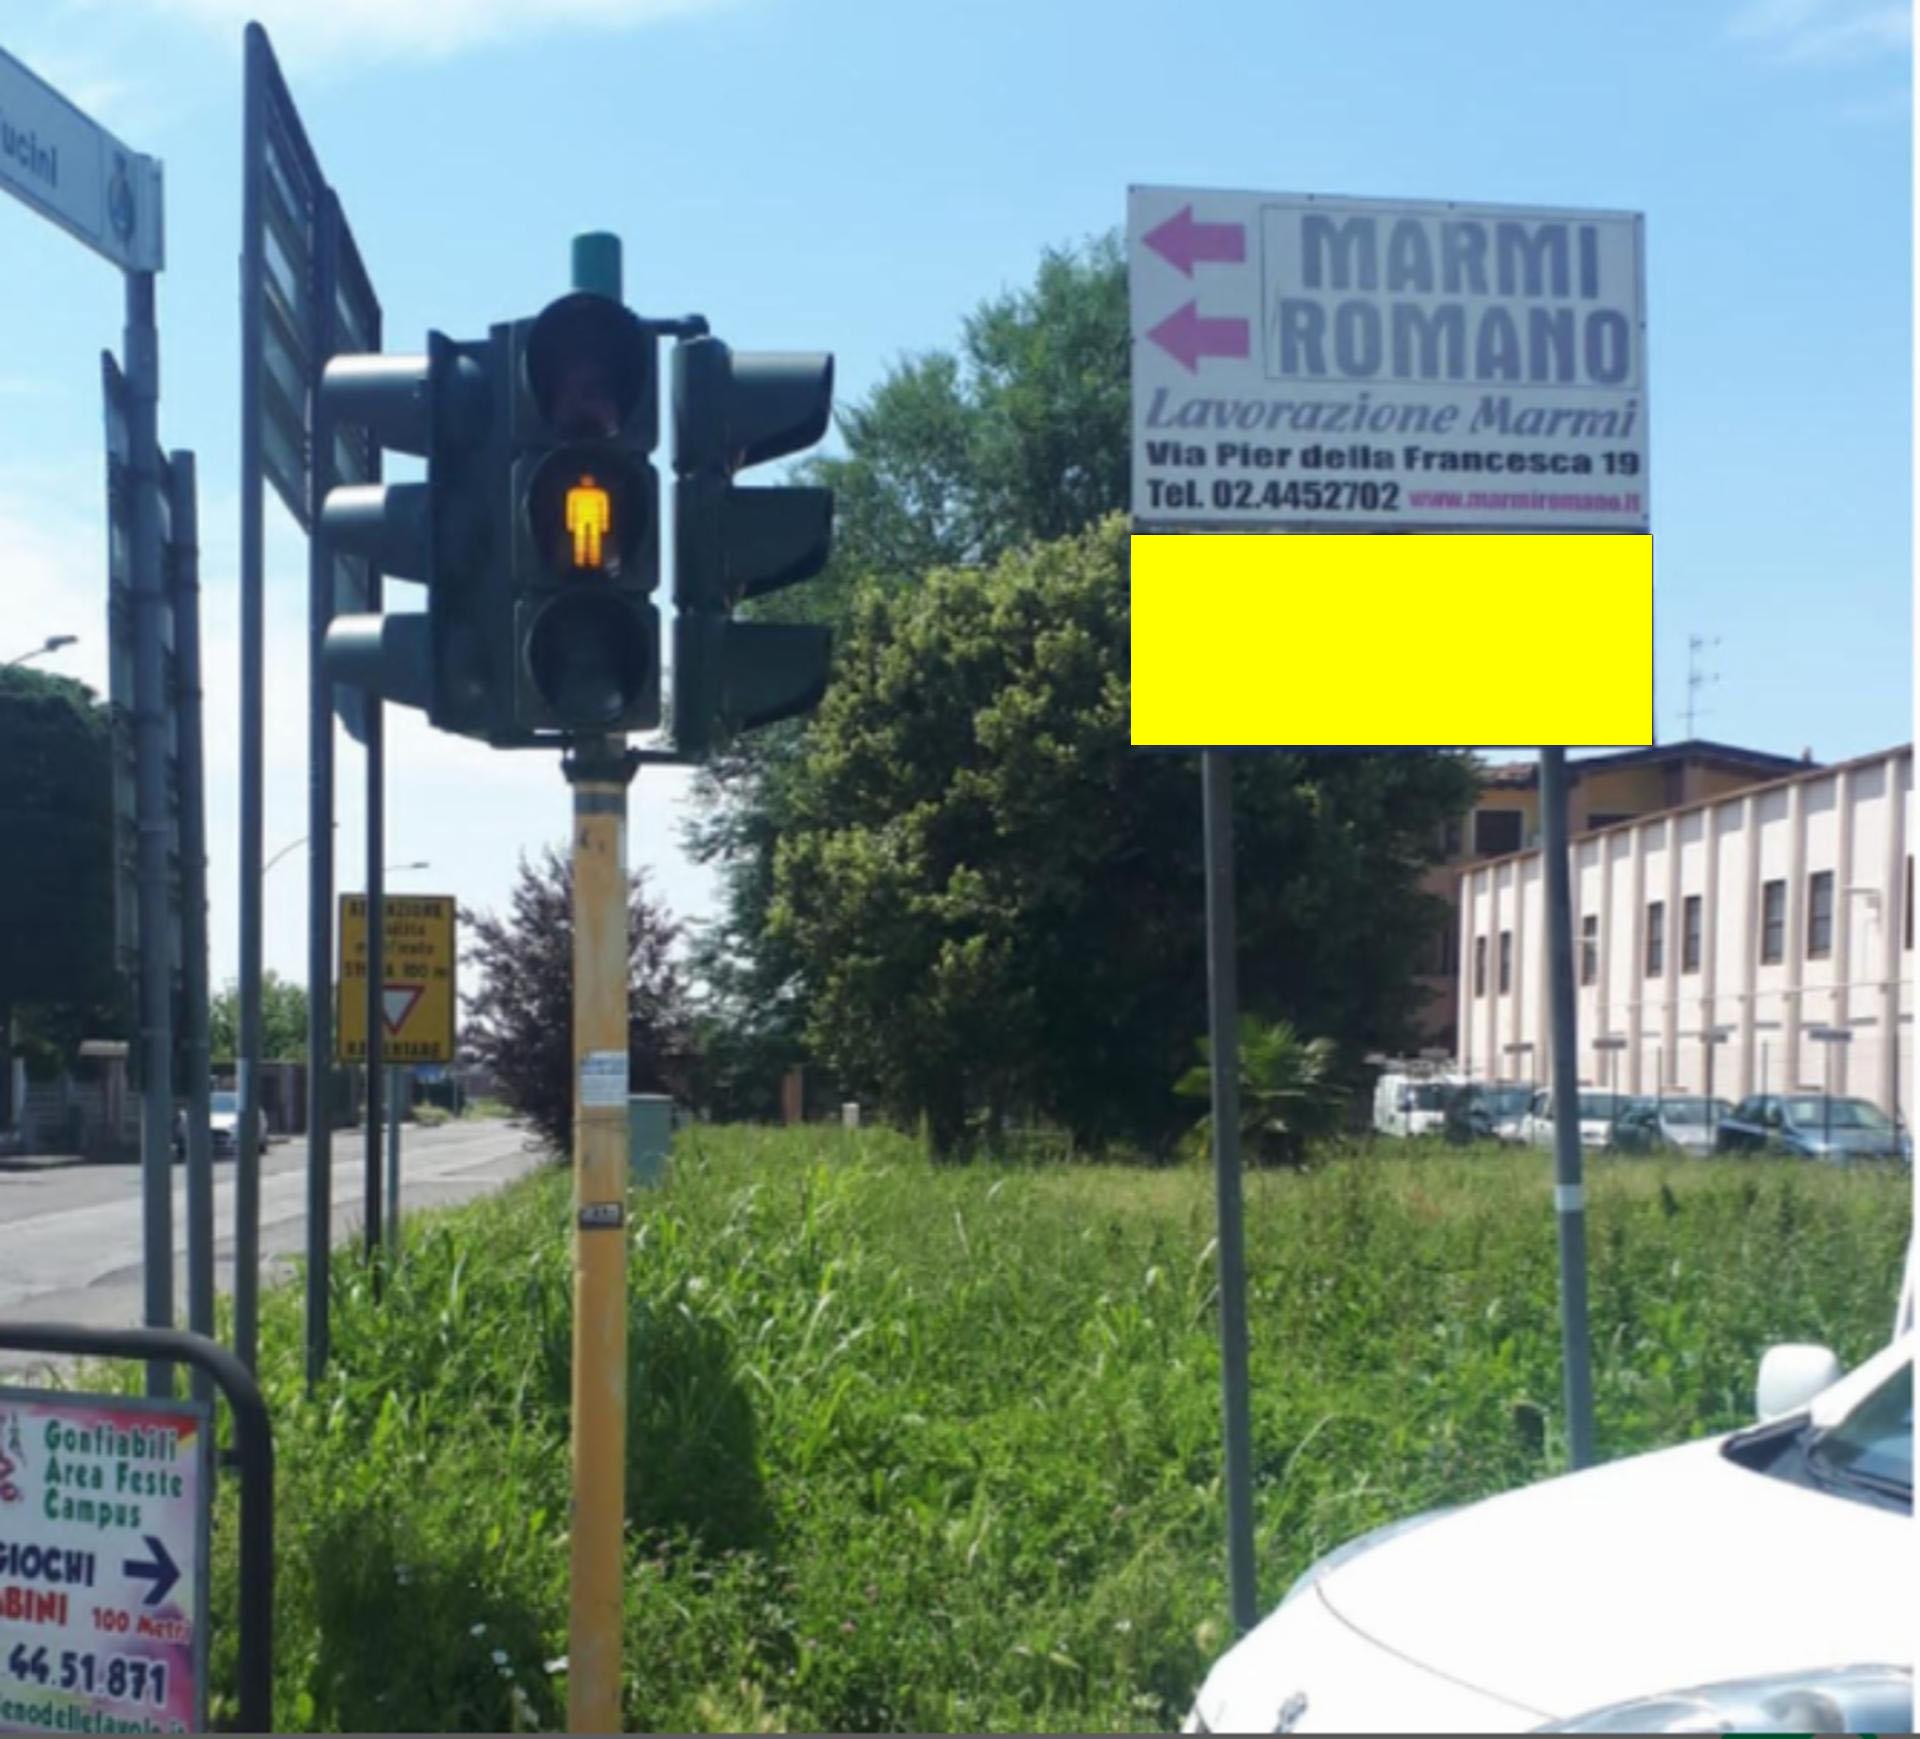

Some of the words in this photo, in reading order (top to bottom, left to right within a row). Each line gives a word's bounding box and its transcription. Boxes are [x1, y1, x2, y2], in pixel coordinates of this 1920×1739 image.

[0, 120, 58, 189] ucini
[1302, 214, 1599, 299] MARMI
[1280, 298, 1629, 384] ROMANO
[1145, 387, 1459, 436] Lavorazione
[1469, 396, 1637, 438] Marmi
[1146, 441, 1206, 467] Via
[1216, 442, 1291, 469] Pier
[1301, 445, 1395, 471] della
[1402, 446, 1592, 475] Francesca
[1602, 451, 1640, 475] 19
[1146, 478, 1204, 509] Tel.
[1213, 479, 1400, 512] 02.4452702
[45, 1420, 177, 1461] Gonfiabili
[45, 1456, 104, 1489] Area
[117, 1462, 183, 1498] Feste
[45, 1488, 142, 1529] Campus
[0, 1586, 67, 1627] BINI
[93, 1606, 130, 1633] 100
